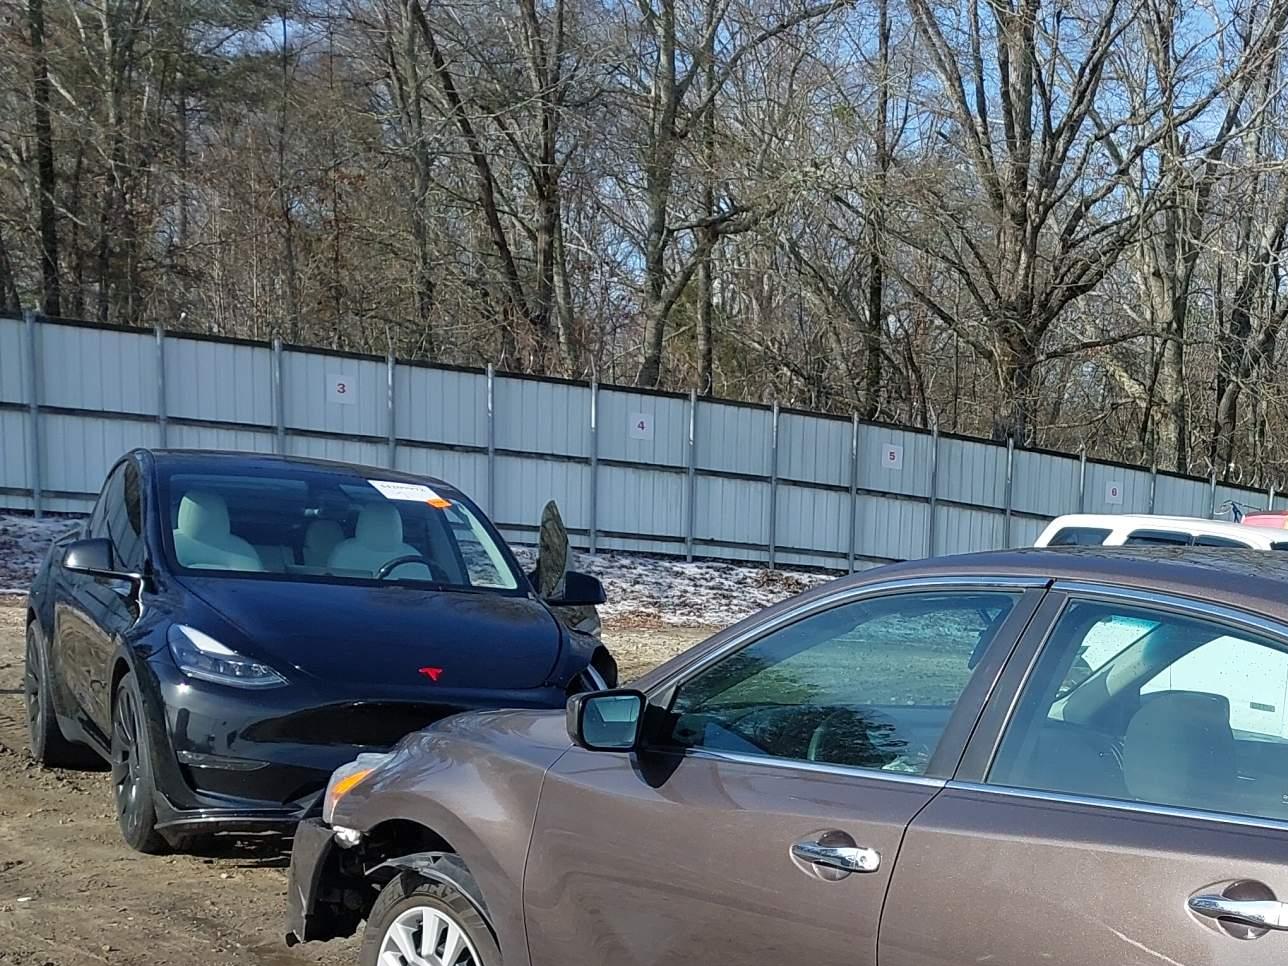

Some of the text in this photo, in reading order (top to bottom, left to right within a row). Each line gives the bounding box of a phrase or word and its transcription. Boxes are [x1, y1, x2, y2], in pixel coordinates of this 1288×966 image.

[336, 382, 347, 395] 3
[637, 420, 646, 432] 4
[888, 451, 897, 462] 5
